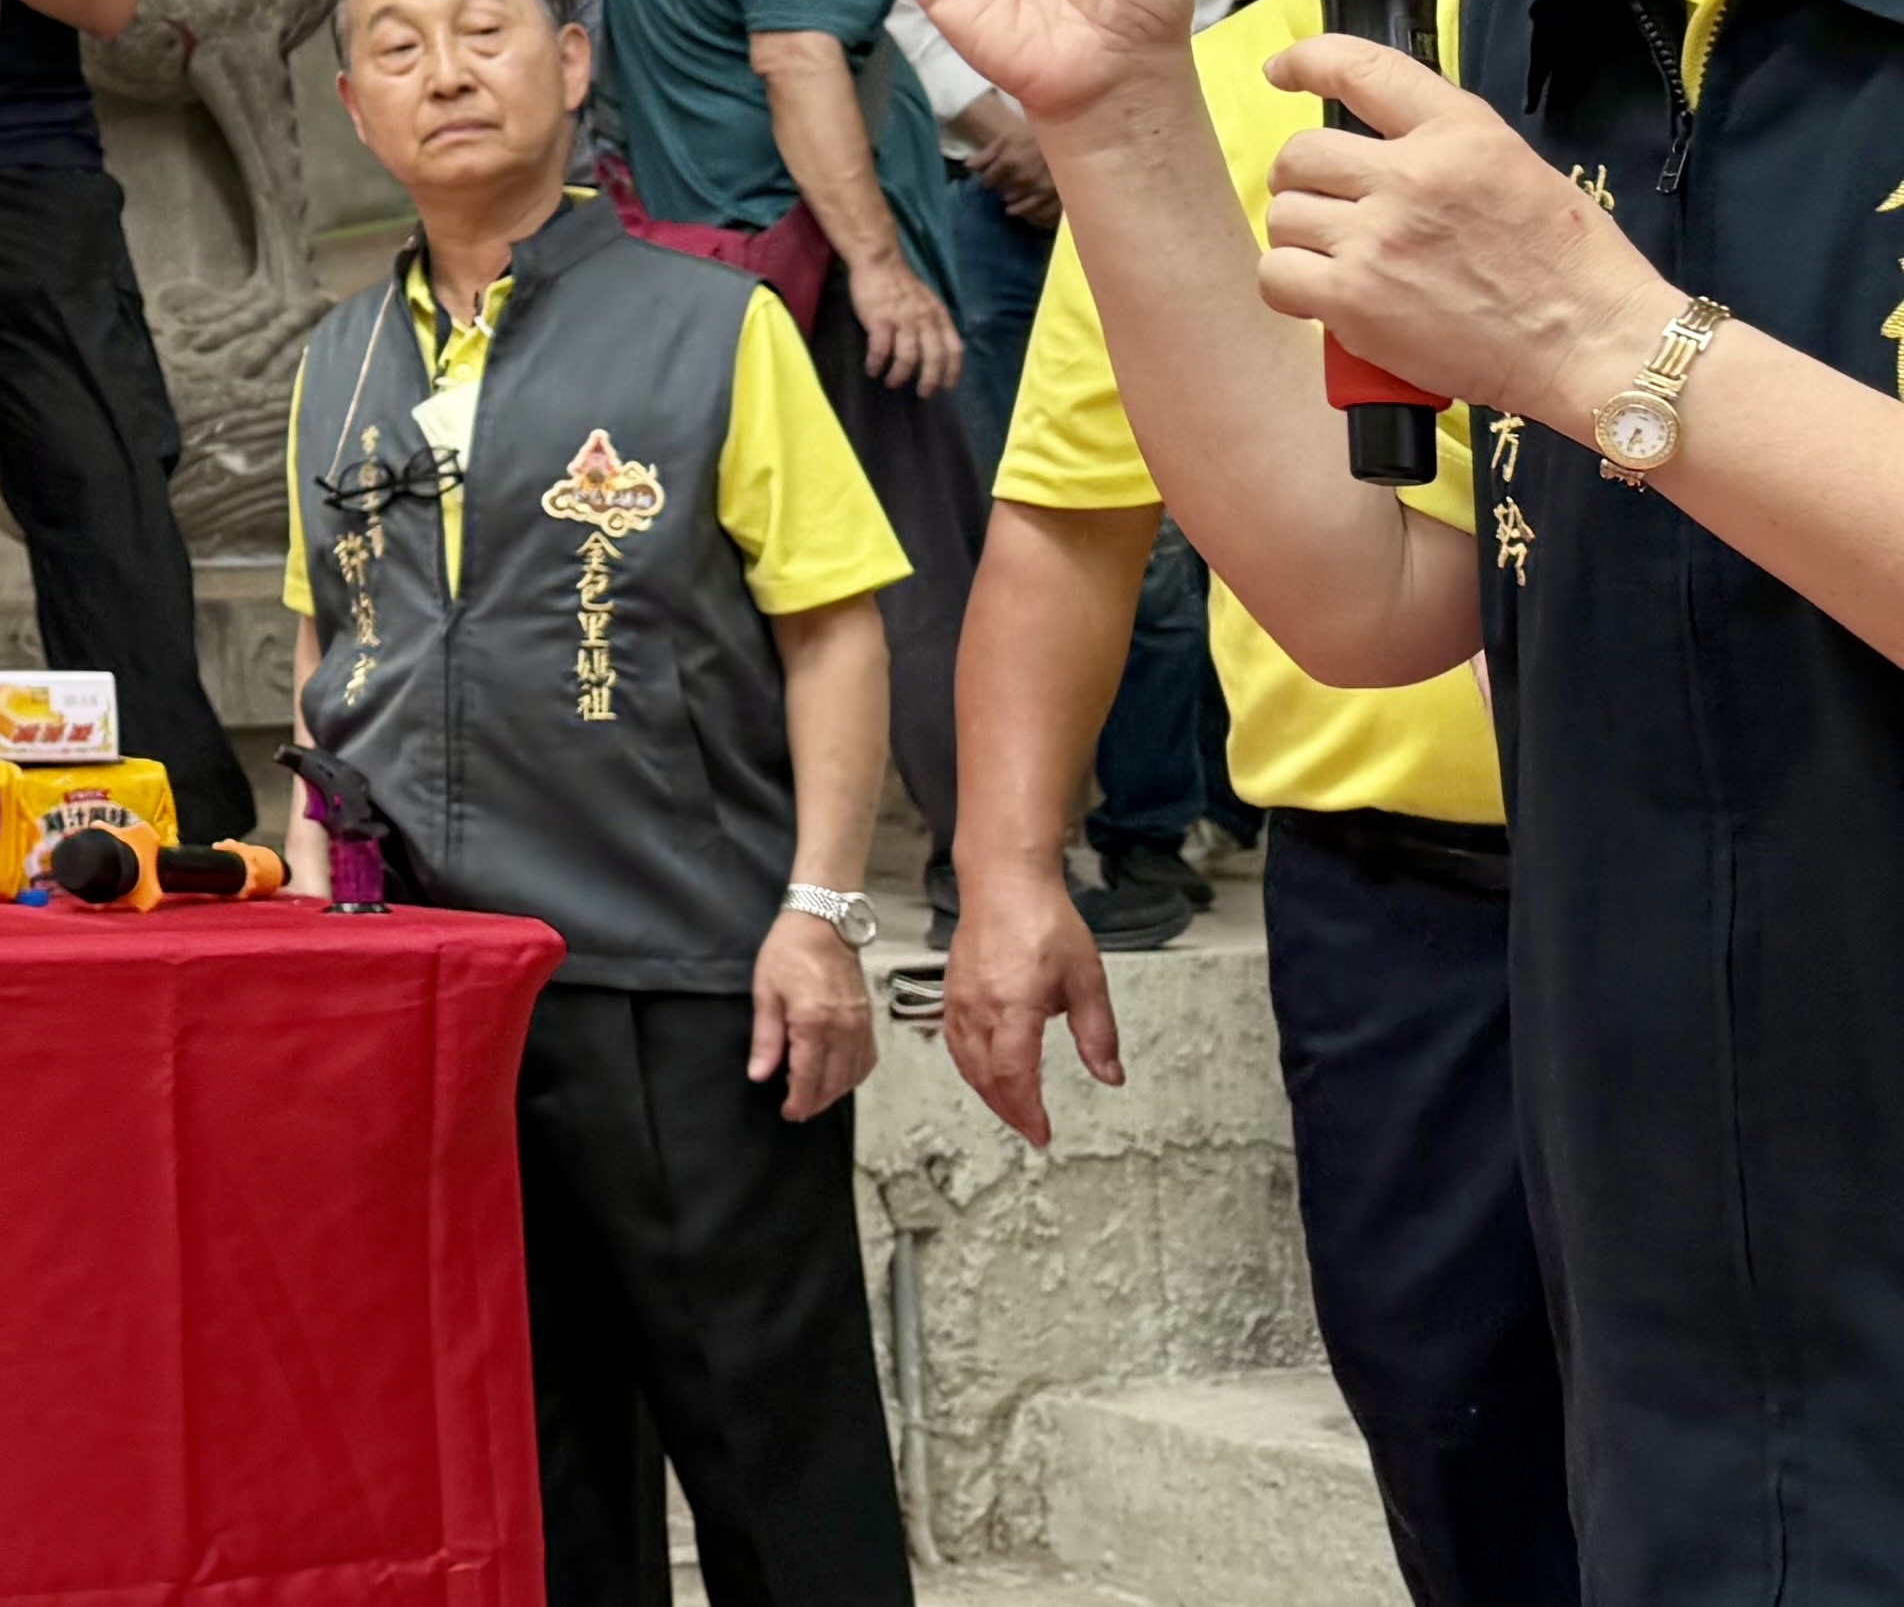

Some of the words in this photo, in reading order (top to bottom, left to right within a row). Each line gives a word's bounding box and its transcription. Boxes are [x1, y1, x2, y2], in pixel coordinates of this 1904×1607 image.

[574, 530, 625, 722] 金包里媽祖
